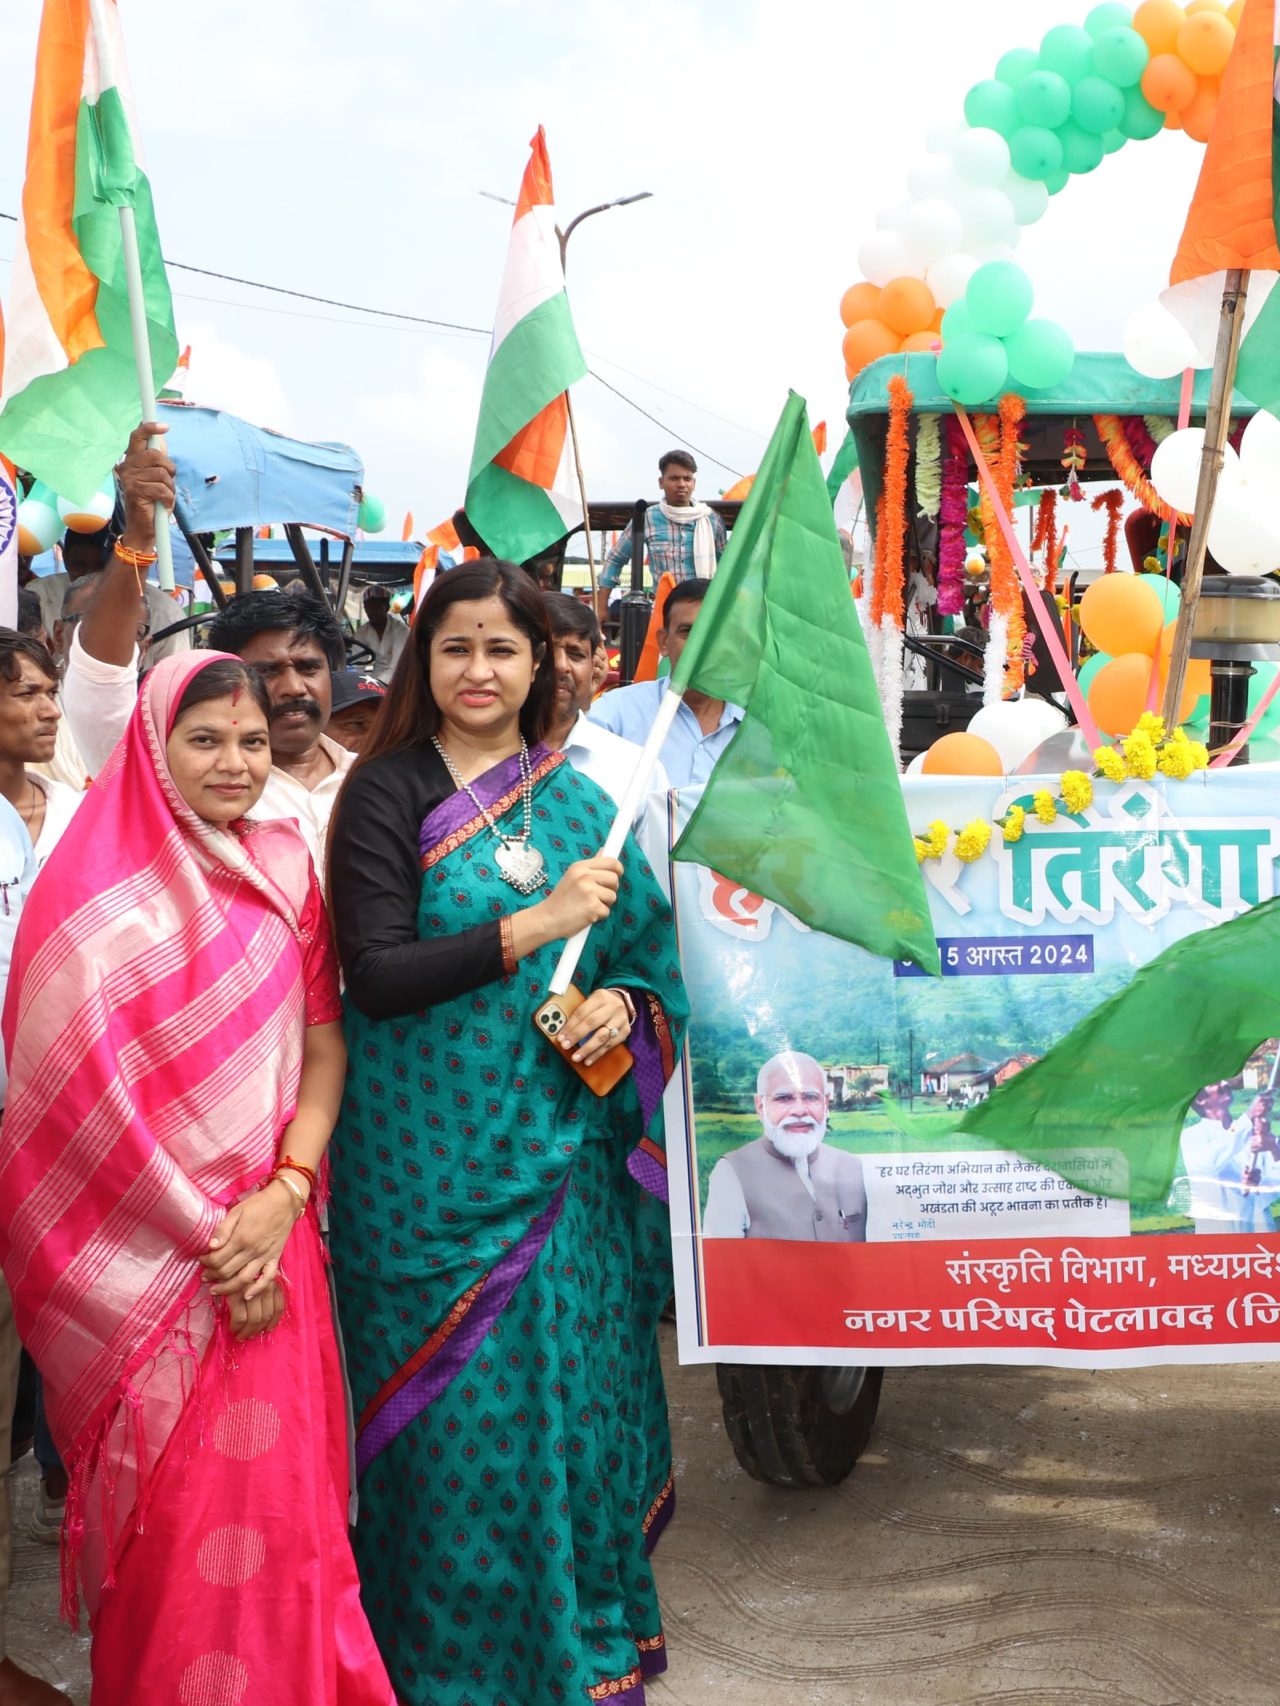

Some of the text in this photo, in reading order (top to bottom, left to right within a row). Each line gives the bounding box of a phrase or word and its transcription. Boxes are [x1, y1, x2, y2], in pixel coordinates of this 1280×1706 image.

[1003, 790, 1272, 913] तिरंगा
[966, 945, 1024, 967] अगस्त
[1030, 944, 1088, 965] 2024
[895, 1165, 910, 1176] घर
[912, 1161, 944, 1176] तिरंगा
[946, 1160, 993, 1175] अभियान
[995, 1160, 1010, 1174] को
[1013, 1159, 1041, 1173] लेकर
[895, 1184, 930, 1199] अद्भुत
[932, 1181, 956, 1194] जोश
[959, 1180, 979, 1194] और
[981, 1181, 1013, 1195] उत्साह
[1040, 1177, 1055, 1191] की
[920, 1201, 959, 1214] अखंडता
[961, 1199, 976, 1213] की
[979, 1201, 1004, 1216] अटूट
[1006, 1200, 1042, 1211] भावना
[1044, 1199, 1060, 1210] का
[1061, 1195, 1094, 1209] प्रतीक
[945, 1248, 1053, 1293] संस्कृति
[1060, 1247, 1157, 1288] विभाग,
[843, 1309, 932, 1333] नगर
[939, 1298, 1058, 1341] परिषद्
[1063, 1298, 1215, 1334] पेटलावद
